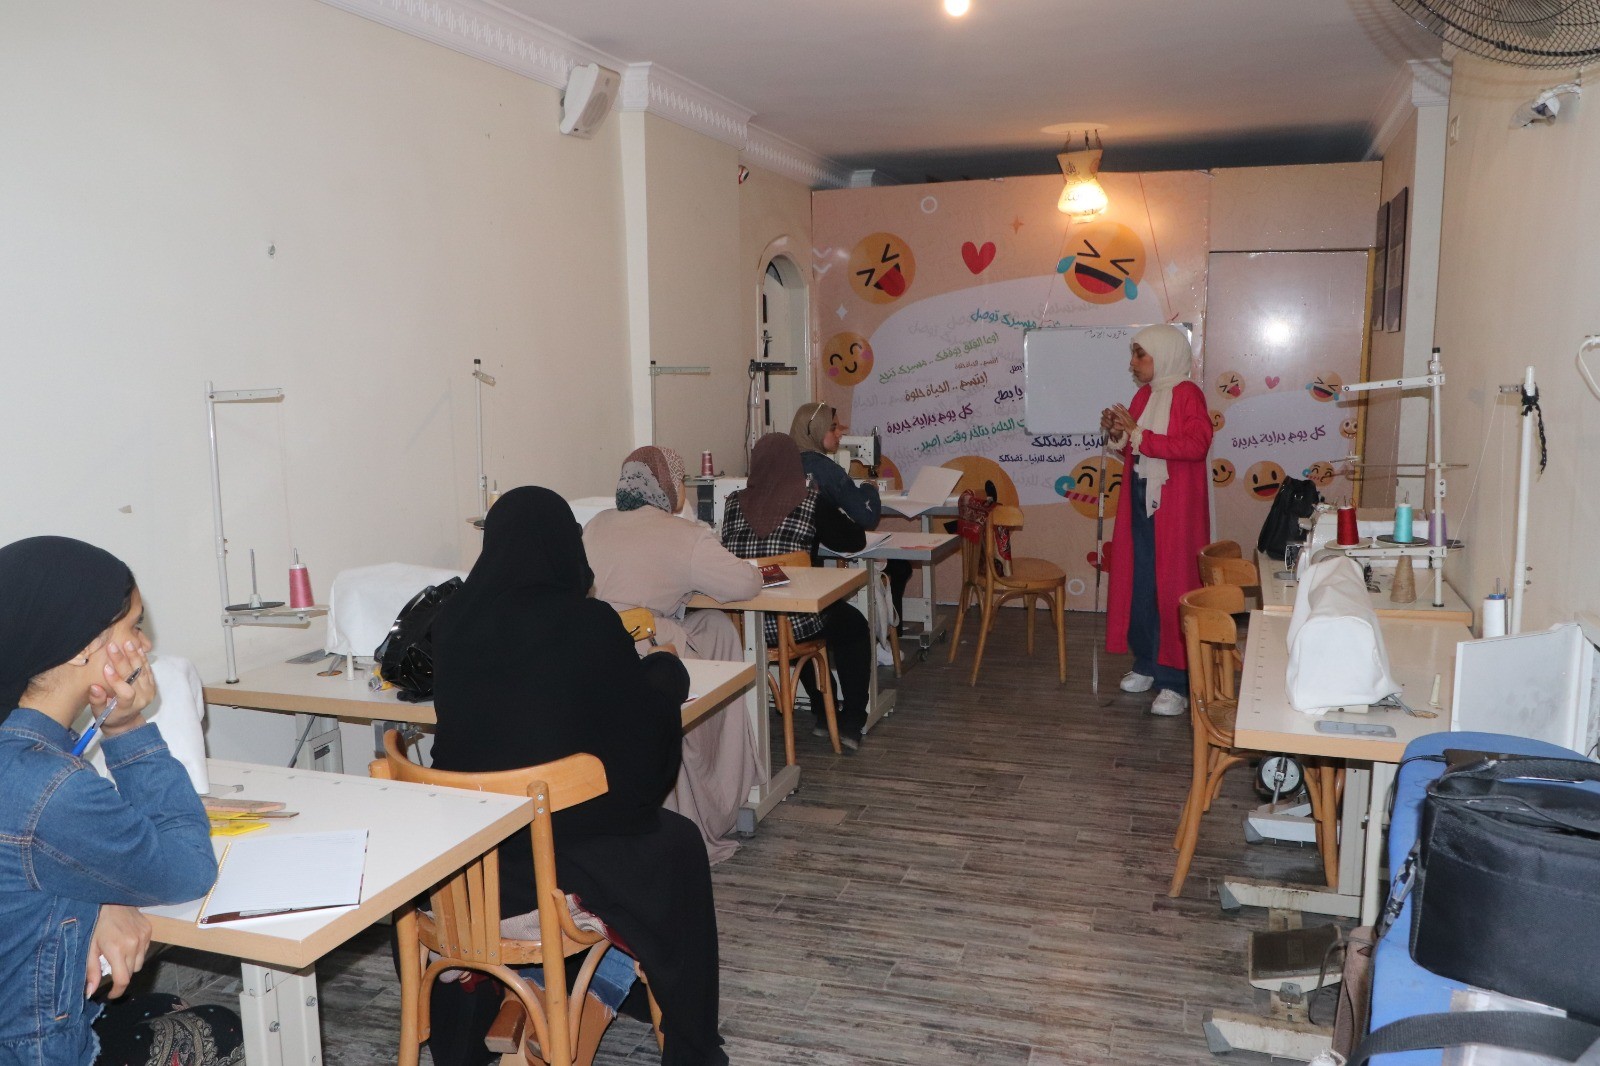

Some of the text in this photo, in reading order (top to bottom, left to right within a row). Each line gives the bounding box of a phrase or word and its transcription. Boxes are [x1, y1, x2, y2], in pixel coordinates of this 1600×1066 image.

[970, 308, 999, 323] توصل
[964, 337, 982, 354] القلق
[935, 348, 961, 361] يوقفك
[897, 360, 928, 375] مسيرك
[960, 371, 988, 391] ابتسم
[905, 387, 925, 402] حلوة
[926, 380, 950, 398] الحياة
[1014, 385, 1024, 400] يا
[938, 410, 956, 423] يوم
[958, 403, 973, 419] كل
[887, 419, 912, 434] جديدة
[913, 413, 936, 429] بداية
[1031, 434, 1072, 448] تضحكلك
[1231, 425, 1326, 449] كل يوم بداية جديدة
[998, 453, 1065, 464] اضحك للدنيا تضحكلك
